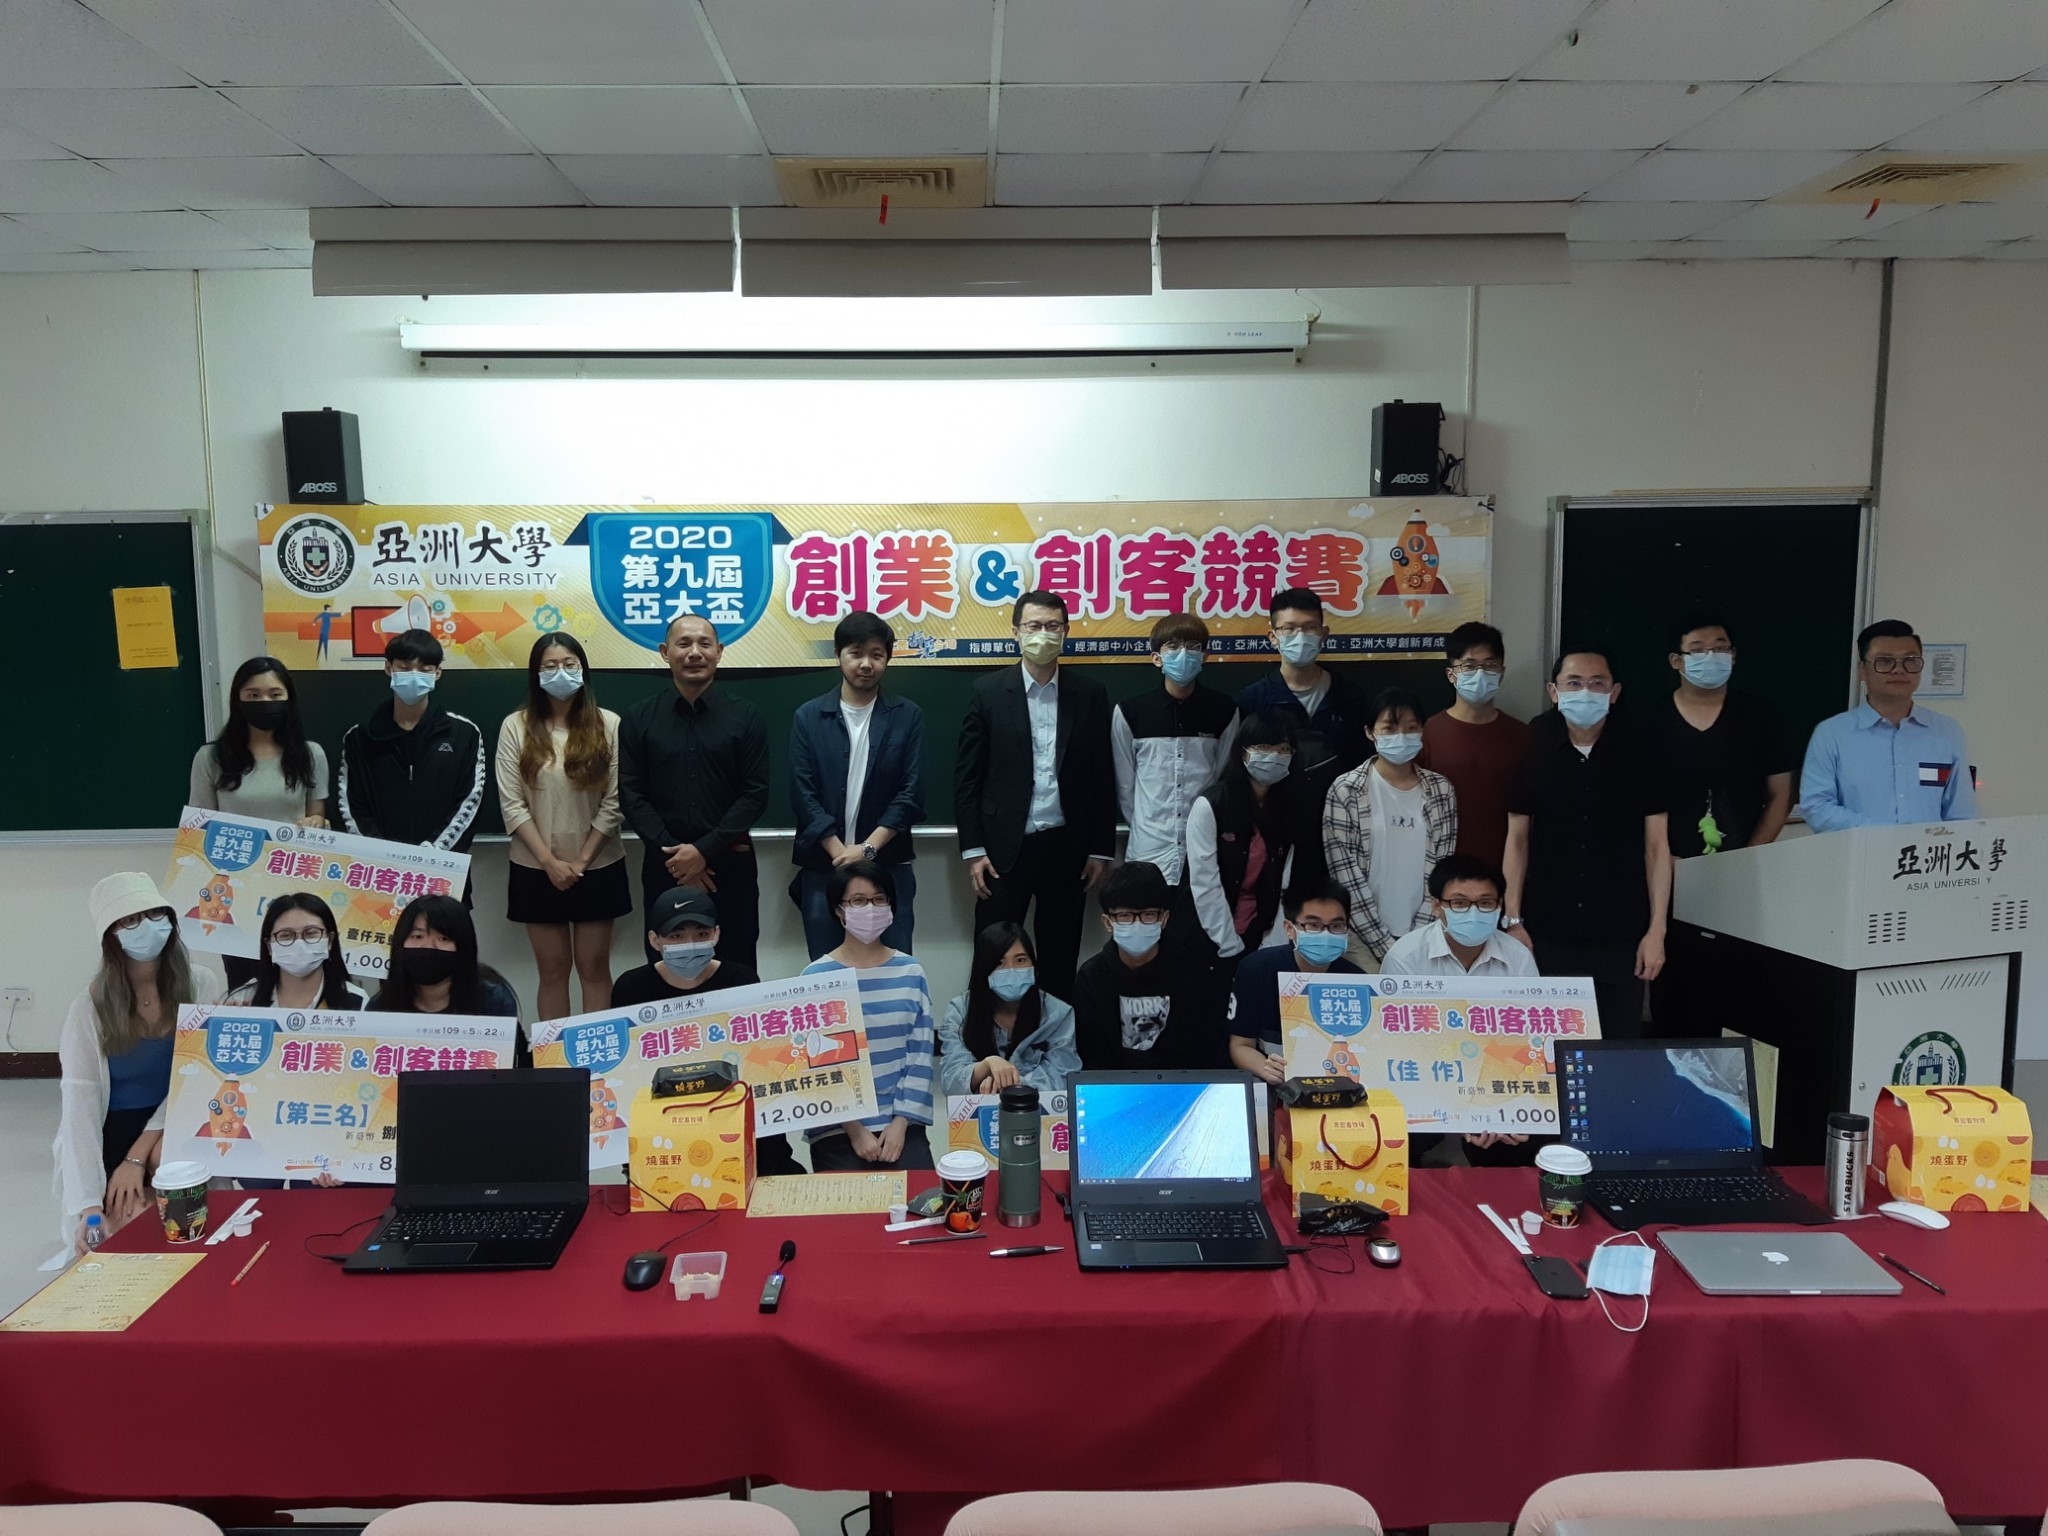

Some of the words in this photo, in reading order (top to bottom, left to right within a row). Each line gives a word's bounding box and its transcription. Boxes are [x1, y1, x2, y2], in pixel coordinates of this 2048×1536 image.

[298, 482, 338, 493] ABOSS
[1390, 473, 1429, 484] ABOSS
[629, 525, 732, 549] 2020
[372, 525, 553, 569] 亞洲大學
[282, 567, 298, 585] ASIA
[303, 566, 351, 592] UNIVERSITY
[373, 573, 420, 585] ASIA
[436, 573, 557, 585] UNIVERSITY
[621, 554, 743, 589] 第九屆
[789, 531, 958, 617] 創業
[975, 550, 1021, 601] &
[1035, 530, 1367, 616] 創客競賽
[622, 590, 745, 625] 亞大盃
[182, 809, 211, 836] Bank
[219, 826, 253, 839] 2020
[295, 830, 337, 845] 亞洲大學
[213, 835, 253, 852] 第九屆
[210, 847, 252, 865] 亞大盃
[1893, 838, 2008, 880] 亞洲大學
[267, 849, 323, 880] 創業
[327, 863, 343, 880] &
[346, 862, 452, 897] 創客競賽
[1906, 882, 1930, 891] ASIA
[1283, 974, 1309, 1005] Bank
[1321, 988, 1357, 998] 2020
[1401, 979, 1445, 991] 亞洲大學
[660, 997, 706, 1015] 亞洲大學
[1122, 998, 1167, 1016] WORK
[1319, 999, 1361, 1013] 第九屆
[179, 1003, 213, 1039] Bank
[222, 1022, 260, 1033] 2020
[309, 1014, 356, 1027] 亞洲大學
[1320, 1012, 1363, 1026] 亞大盃
[1381, 1004, 1441, 1033] 創業
[1446, 1009, 1464, 1029] &
[1468, 1005, 1586, 1034] 創客競賽
[533, 1021, 565, 1054] Bank
[577, 1024, 615, 1039] 2020
[640, 1023, 701, 1060] 創業
[707, 1022, 726, 1043] &
[729, 1000, 849, 1044] 創客競賽
[217, 1034, 261, 1049] 第九屆
[574, 1036, 619, 1053] 第九屆
[216, 1049, 261, 1064] 亞大盃
[281, 1041, 344, 1073] 創業
[349, 1048, 368, 1069] &
[372, 1044, 498, 1077] 創客競賽
[576, 1049, 621, 1067] 亞大盃
[753, 1070, 844, 1099] 壹萬貳仟元整
[1491, 1080, 1551, 1095] 壹仟元整
[760, 1100, 833, 1126] 12,000
[950, 1095, 981, 1131] Bank
[1499, 1108, 1556, 1126] 1,000
[645, 1155, 682, 1166] 燒蛋野
[1309, 1159, 1346, 1171] 燒蛋野
[1930, 1155, 1968, 1166] 燒蛋野
[1843, 1151, 1855, 1213] STARBUCKS
